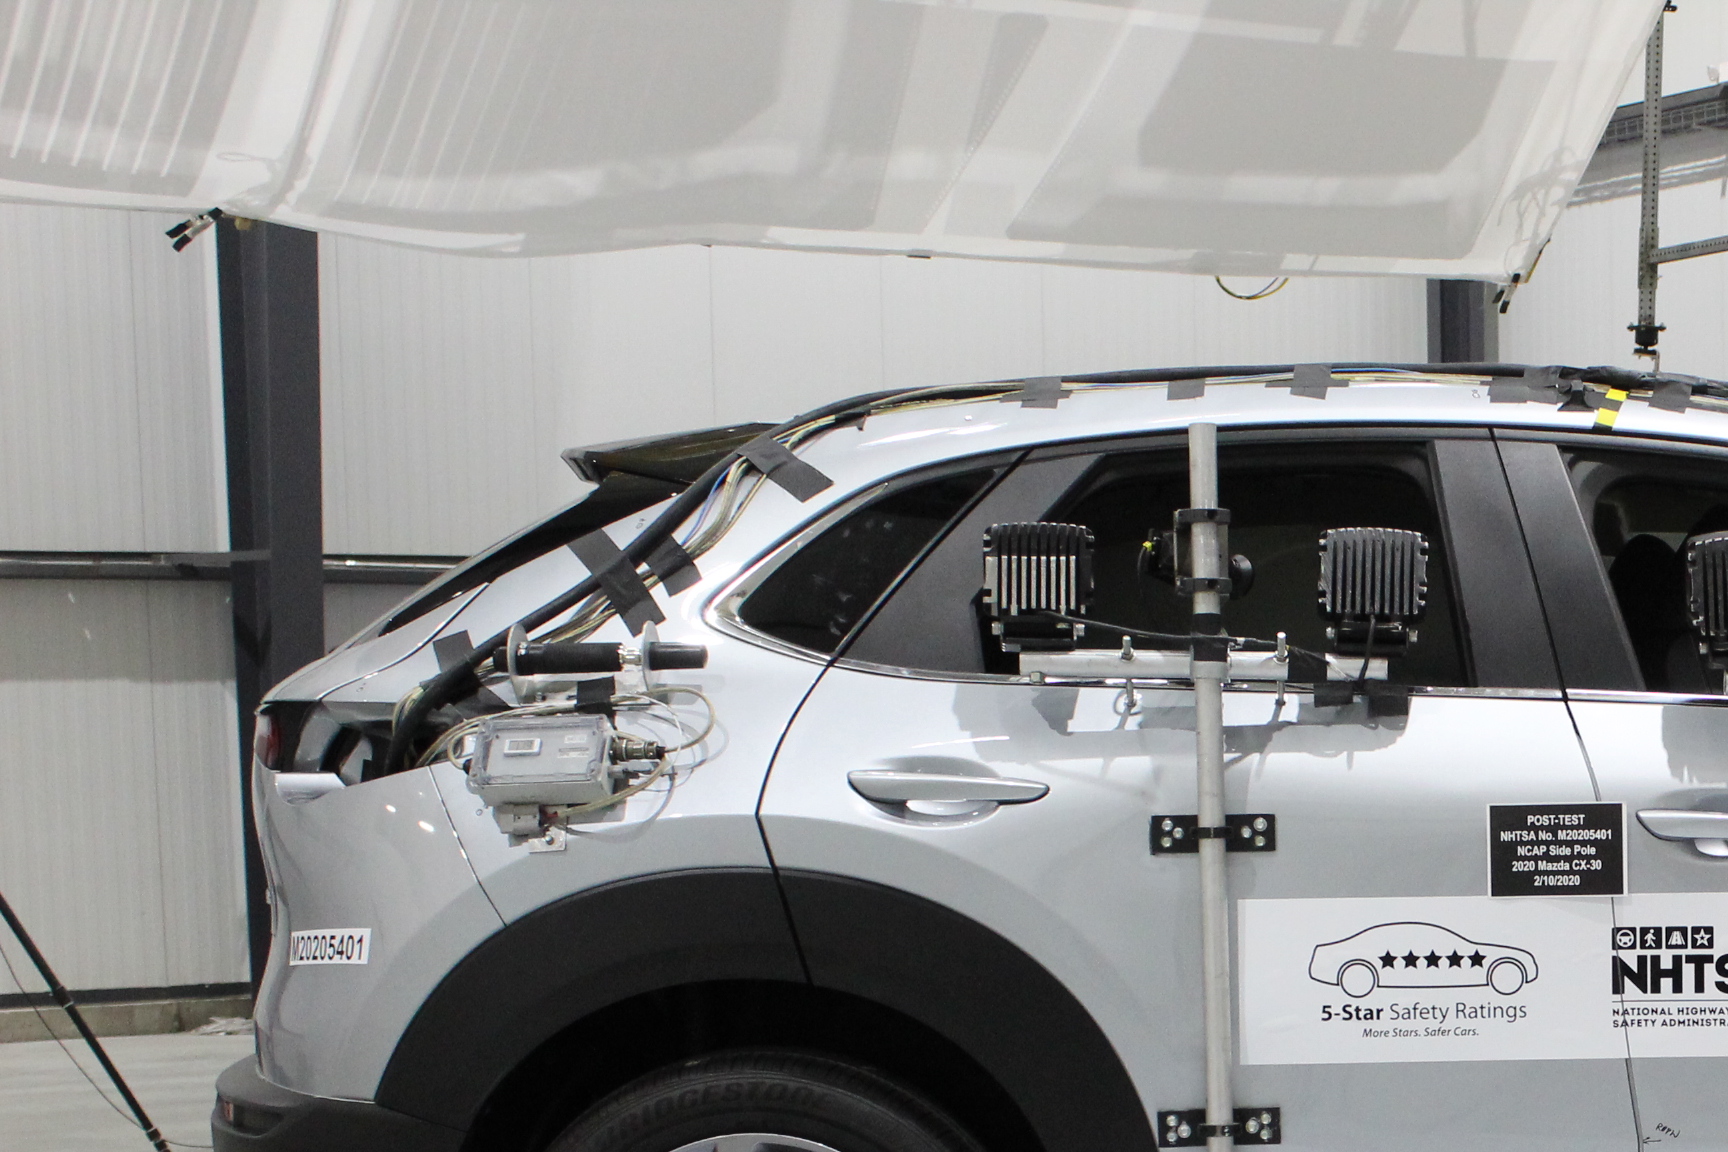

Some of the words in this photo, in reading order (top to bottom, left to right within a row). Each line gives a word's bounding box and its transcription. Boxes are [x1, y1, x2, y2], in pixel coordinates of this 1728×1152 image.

[1527, 814, 1585, 826] POST-TEST
[1500, 830, 1537, 842] NHTSA
[1538, 830, 1556, 841] No.
[1557, 829, 1612, 841] M20205401
[1517, 845, 1547, 856] NCAP
[1549, 845, 1572, 856] Side
[1574, 844, 1597, 856] Pole
[1512, 860, 1536, 872] 2020
[1538, 860, 1570, 871] Mazda
[1572, 859, 1602, 871] CX-30
[1534, 875, 1581, 886] 2/10/2020
[292, 934, 364, 962] M20205401
[1321, 1003, 1384, 1021] 5-Star
[1389, 1003, 1450, 1024] Safety
[1455, 1002, 1527, 1023] Ratings
[1612, 1007, 1673, 1016] NATIONAL
[1612, 1019, 1657, 1028] SAFETY
[1362, 1028, 1390, 1038] More
[1392, 1027, 1421, 1038] Stars.
[1423, 1027, 1452, 1037] Safer
[1453, 1026, 1480, 1037] Cars.
